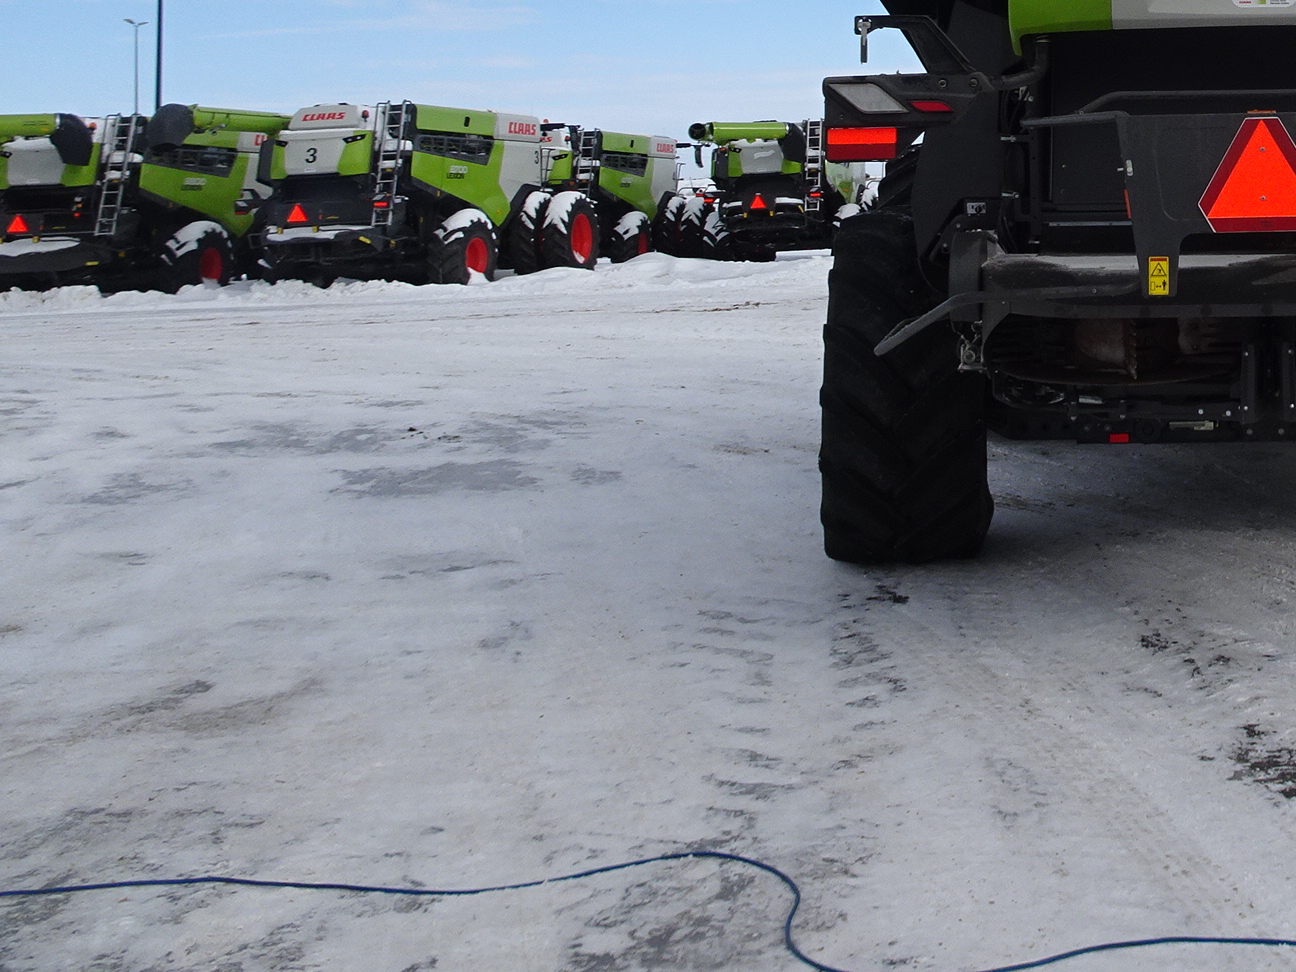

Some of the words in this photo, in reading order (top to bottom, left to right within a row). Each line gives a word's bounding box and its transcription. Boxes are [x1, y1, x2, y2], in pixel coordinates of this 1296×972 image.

[301, 112, 346, 121] CLAAS
[508, 122, 537, 135] CLAAS
[305, 147, 318, 163] 3
[534, 150, 540, 164] 3
